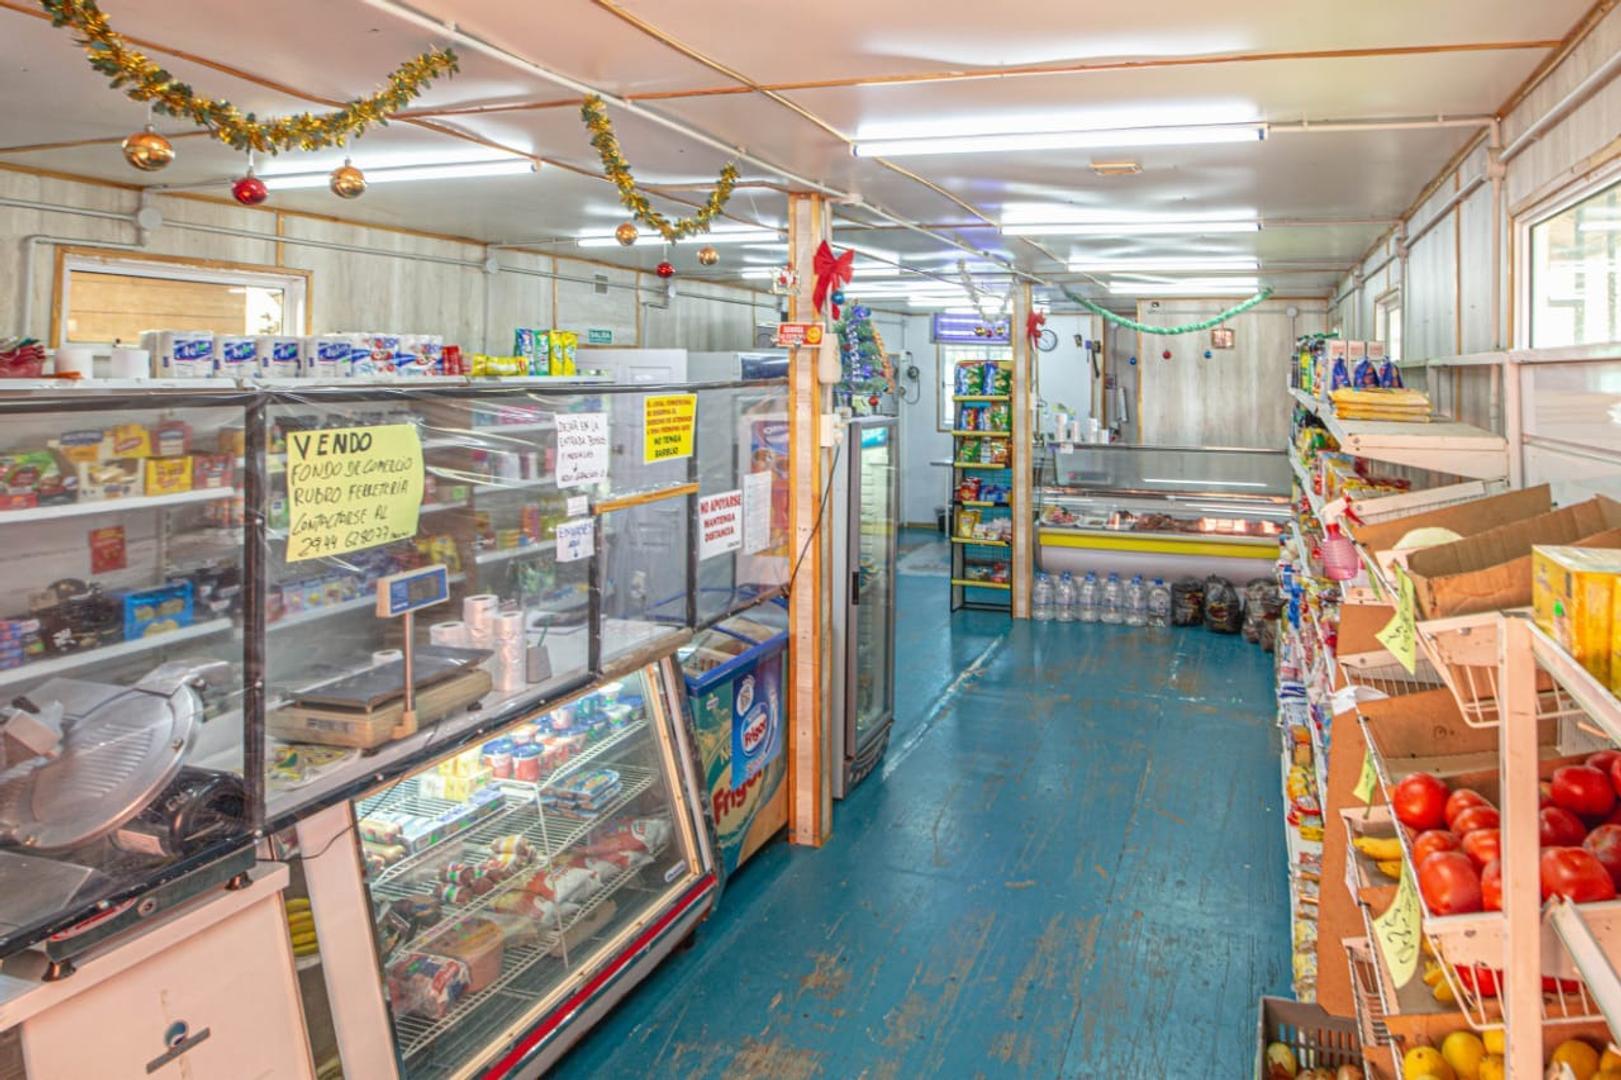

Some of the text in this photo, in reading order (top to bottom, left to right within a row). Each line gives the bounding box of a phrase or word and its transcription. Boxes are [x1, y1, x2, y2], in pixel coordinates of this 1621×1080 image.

[294, 432, 373, 460] VENDO
[654, 434, 682, 445] NO TENGA
[291, 461, 343, 487] FONDO
[345, 460, 360, 477] DE
[294, 486, 342, 506] RUBRO
[701, 495, 741, 514] NO APOYARSE
[375, 505, 388, 520] AL
[704, 513, 735, 528] MANTENGA
[705, 526, 734, 543] DISTANCIA
[298, 535, 338, 557] 2944
